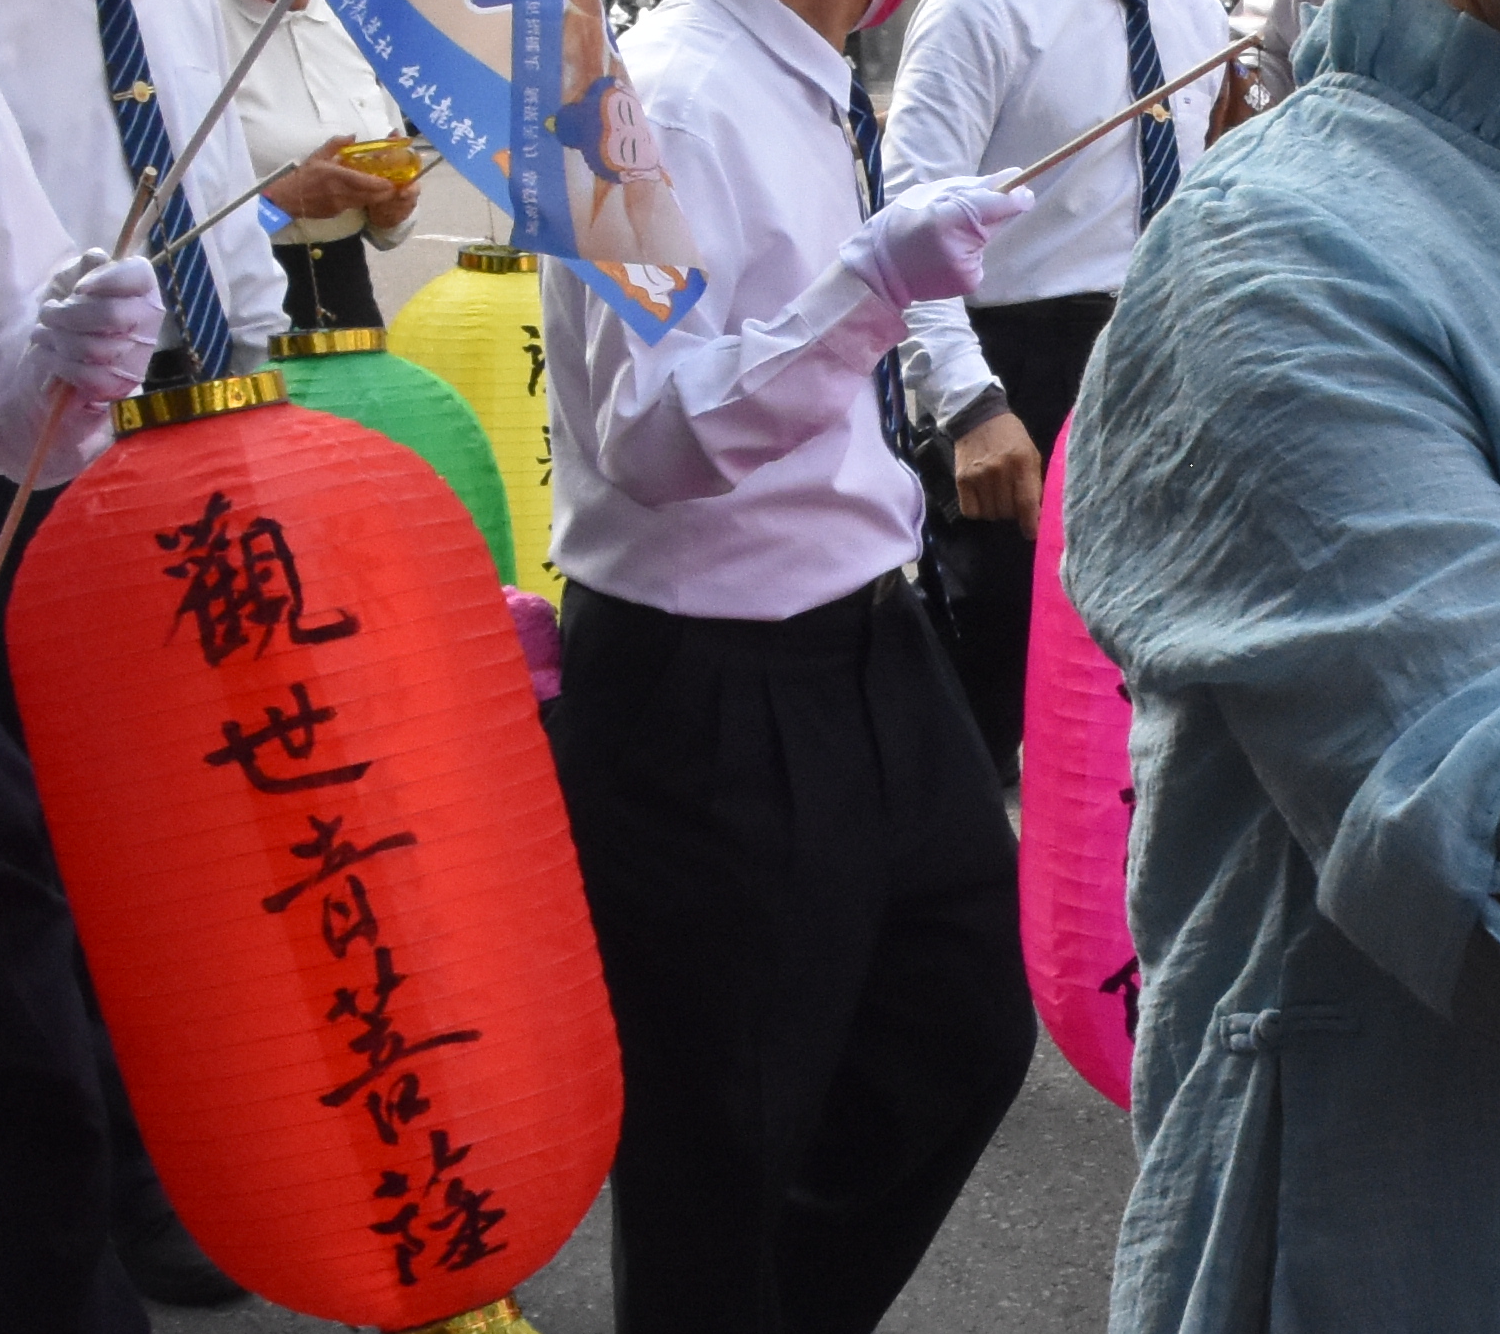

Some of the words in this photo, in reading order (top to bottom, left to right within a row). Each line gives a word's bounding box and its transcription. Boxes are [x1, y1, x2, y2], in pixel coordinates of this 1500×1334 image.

[156, 492, 507, 1286] 觀世音菩薩
